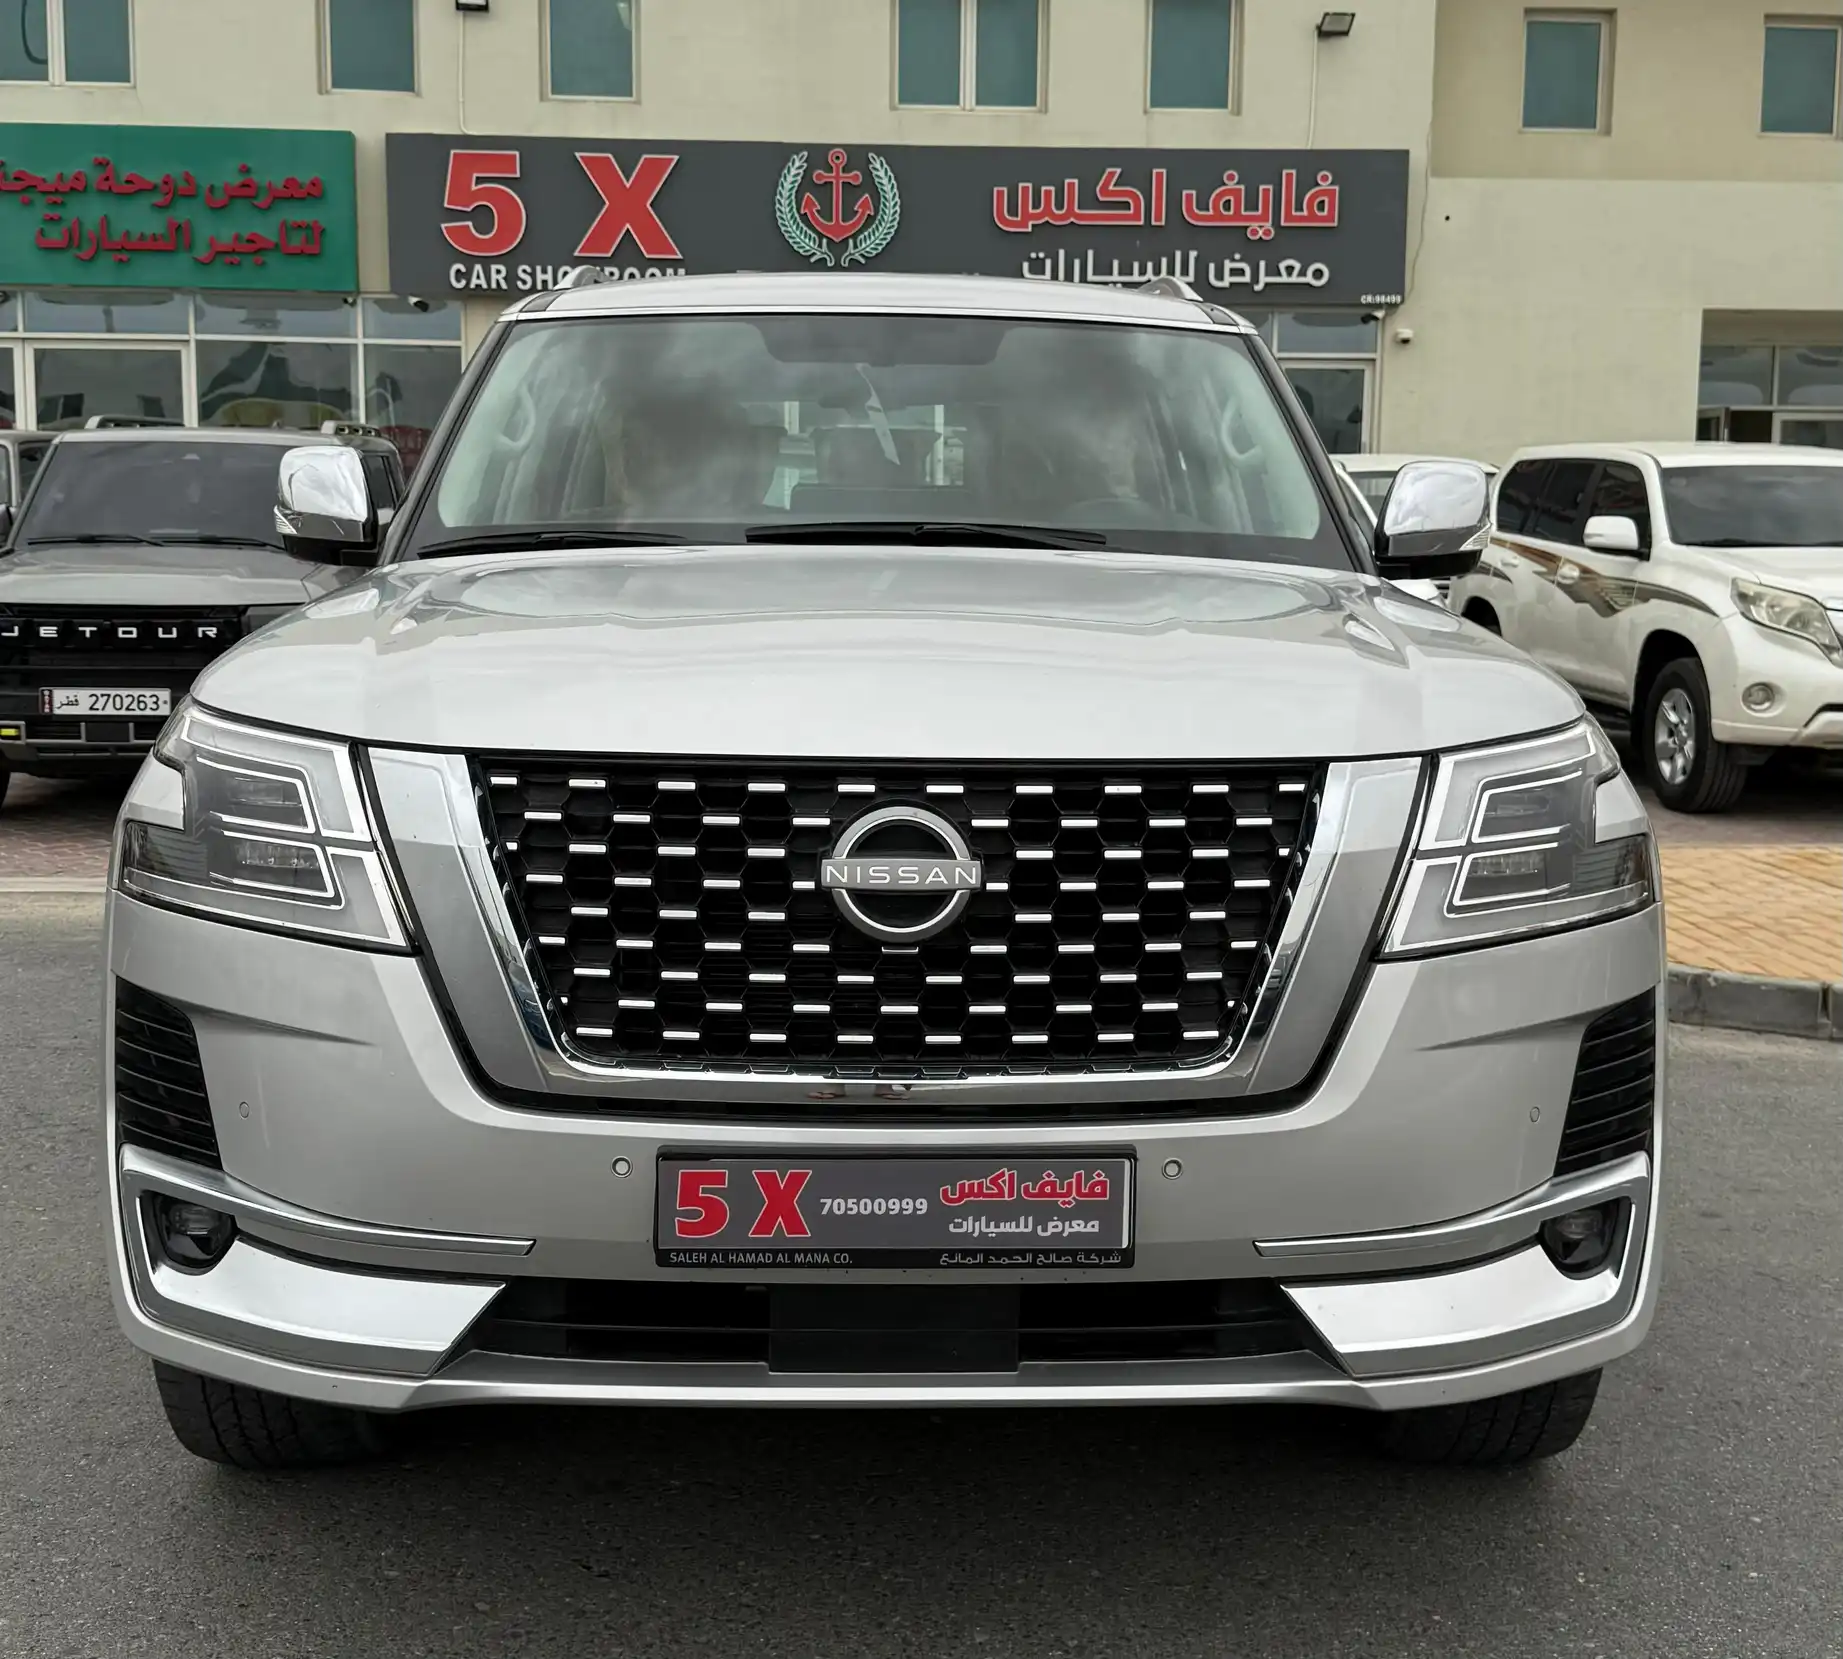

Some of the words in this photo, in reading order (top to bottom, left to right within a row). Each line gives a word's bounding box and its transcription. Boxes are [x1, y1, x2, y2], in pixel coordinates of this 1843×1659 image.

[93, 156, 197, 208] دوحة
[205, 163, 324, 210] معرض
[441, 149, 527, 256] 5
[573, 151, 683, 259] X
[992, 167, 1167, 232] اكس
[1181, 168, 1340, 240] فايف
[35, 213, 192, 263] السيارات
[194, 219, 324, 265] لتاجير
[449, 263, 508, 290] CAR
[516, 265, 686, 291] SHOR
[1208, 253, 1330, 291] معرض
[1, 626, 218, 639] JETOUR
[88, 693, 160, 712] 270263
[826, 865, 976, 885] NISSAN
[939, 1168, 1018, 1206] اكس
[1021, 1170, 1110, 1208] فايف
[674, 1169, 730, 1239] 5
[748, 1169, 812, 1238] X
[820, 1197, 929, 1216] 70500999
[948, 1215, 1034, 1238] للسيارات
[1036, 1216, 1100, 1237] معرض
[669, 1252, 707, 1264] SALEH
[710, 1252, 725, 1264] AL
[728, 1252, 773, 1265] HAMAD
[776, 1252, 791, 1265] AL
[794, 1252, 830, 1265] MANA
[833, 1252, 853, 1265] CO.
[987, 1251, 1033, 1265] الحمد
[1036, 1252, 1073, 1266] صالح
[1076, 1250, 1122, 1265] شركة
